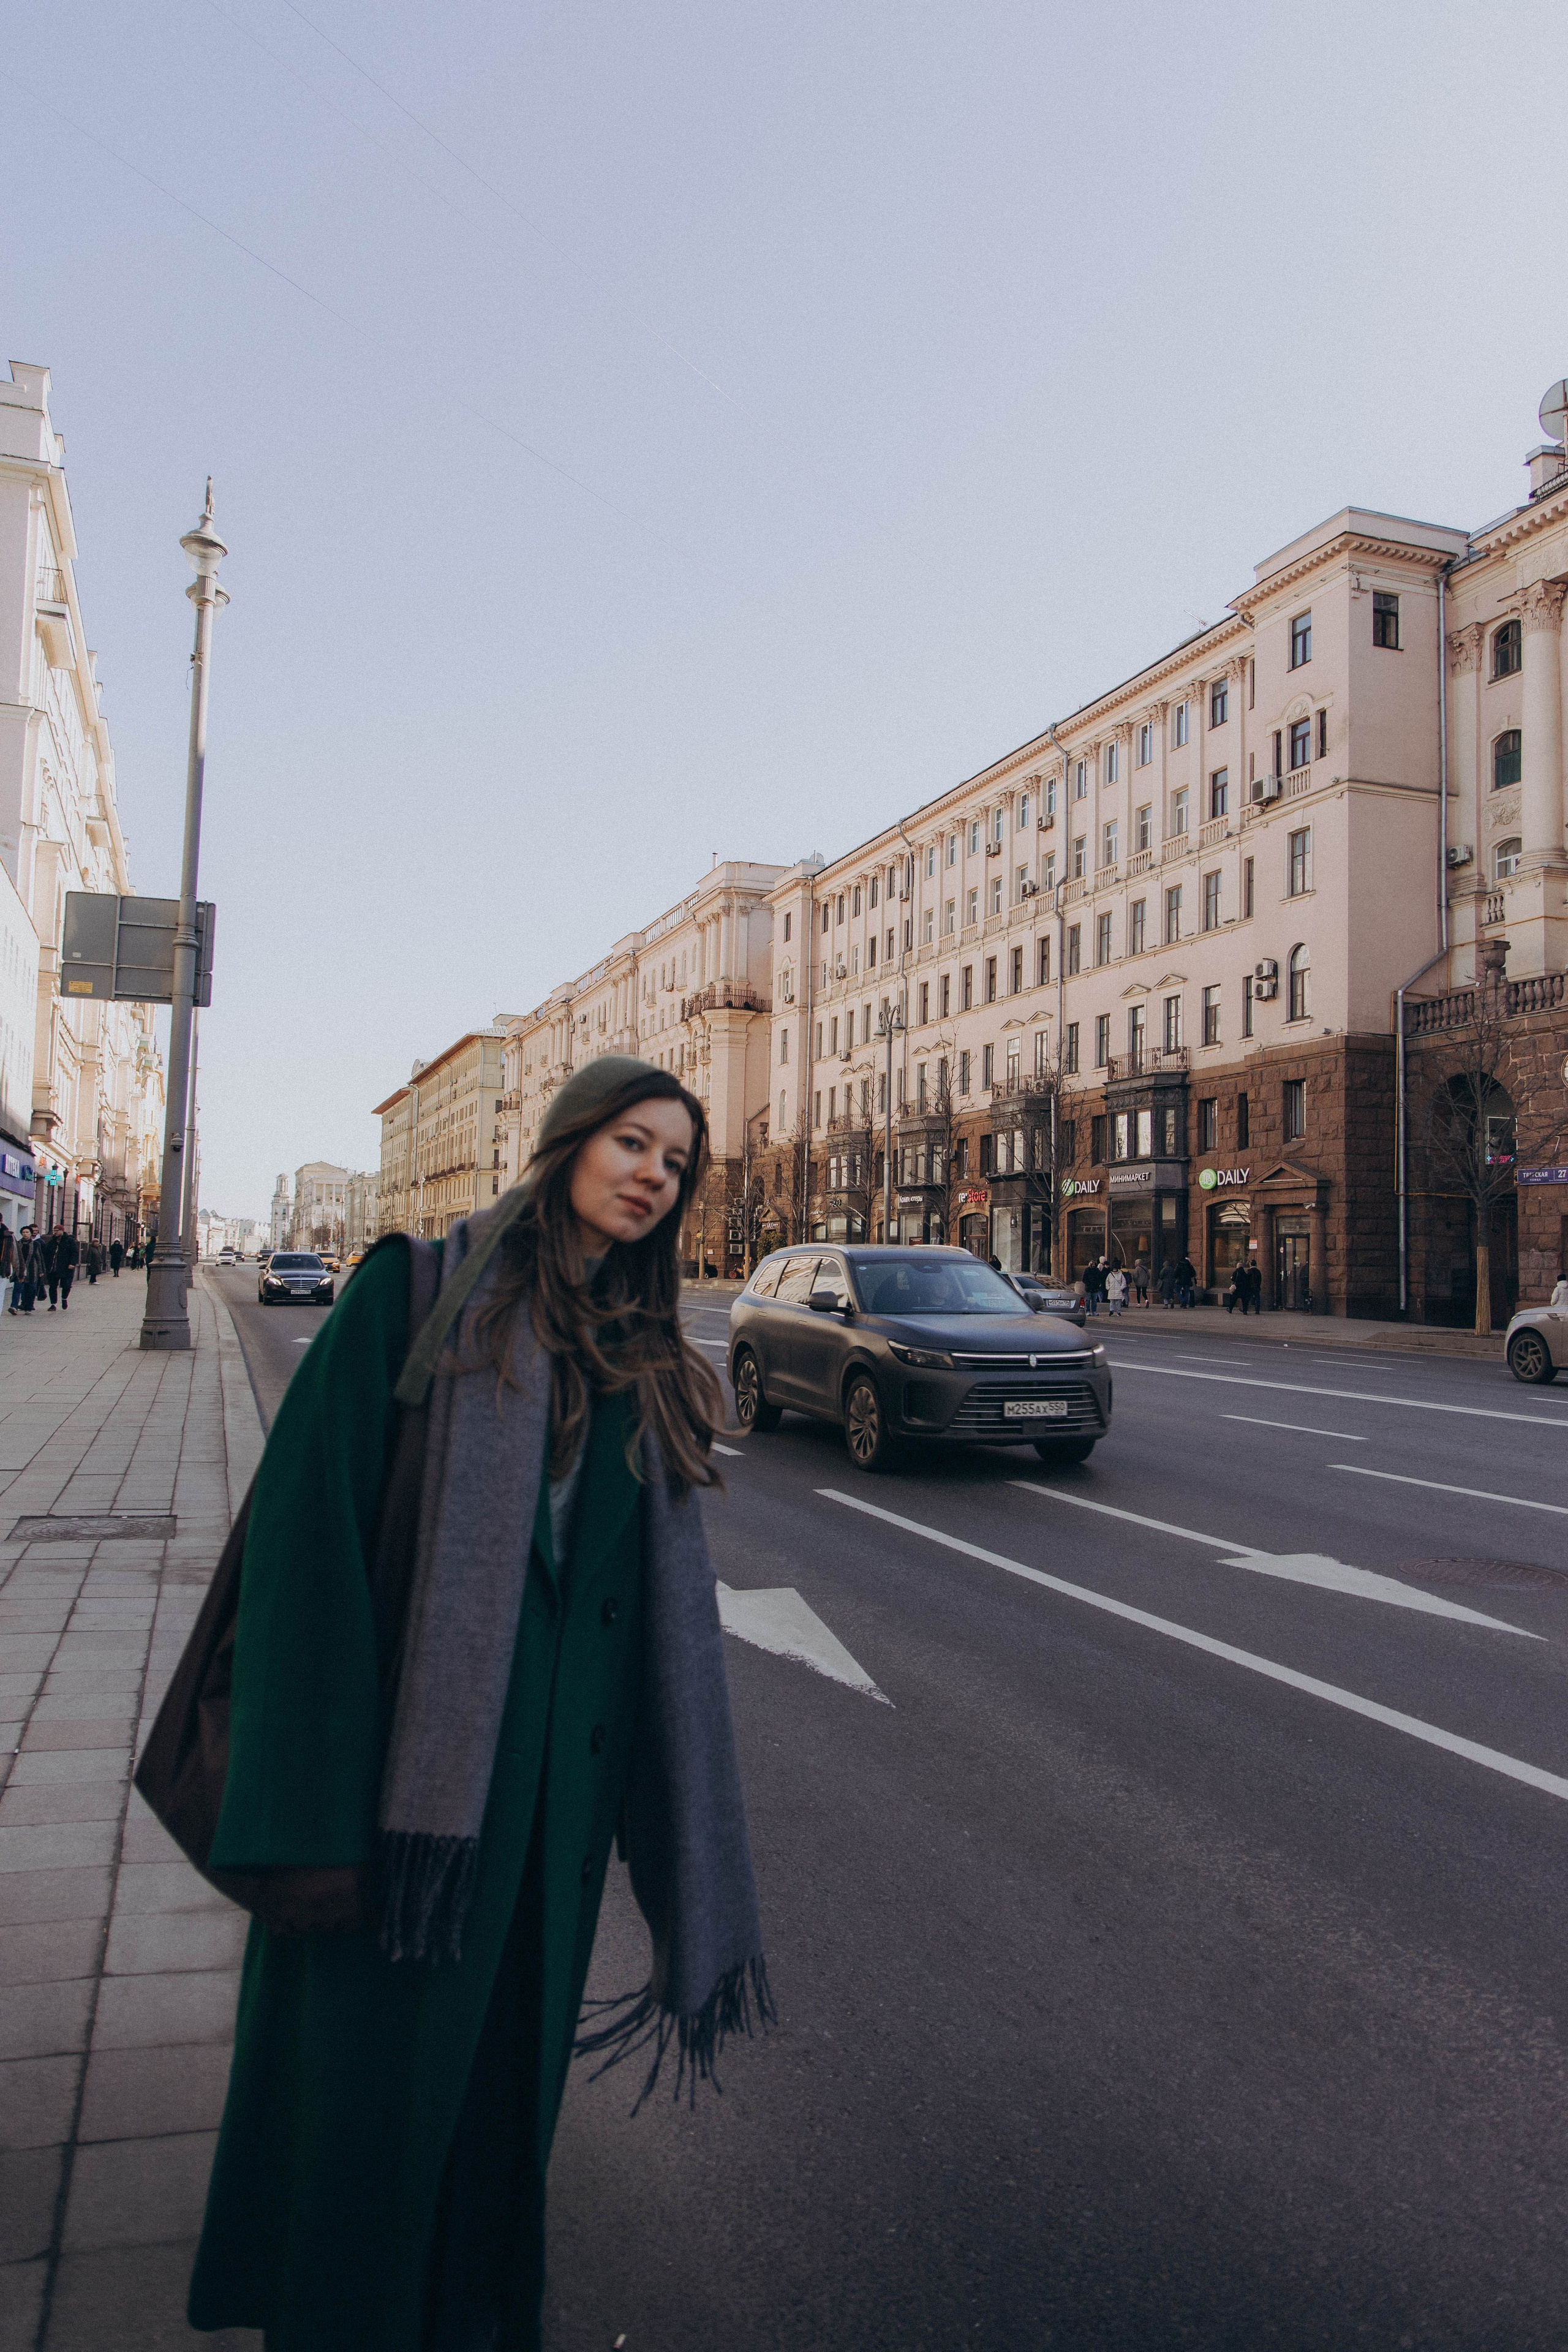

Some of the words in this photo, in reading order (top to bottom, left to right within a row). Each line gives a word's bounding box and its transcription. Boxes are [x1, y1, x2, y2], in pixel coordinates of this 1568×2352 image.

[1110, 1172, 1149, 1183] МИНИМАРКЕТ
[1216, 1167, 1250, 1186] DAILY
[1558, 1169, 1567, 1178] 27
[1074, 1179, 1101, 1194] DAILY
[958, 1188, 986, 1203] re:Store
